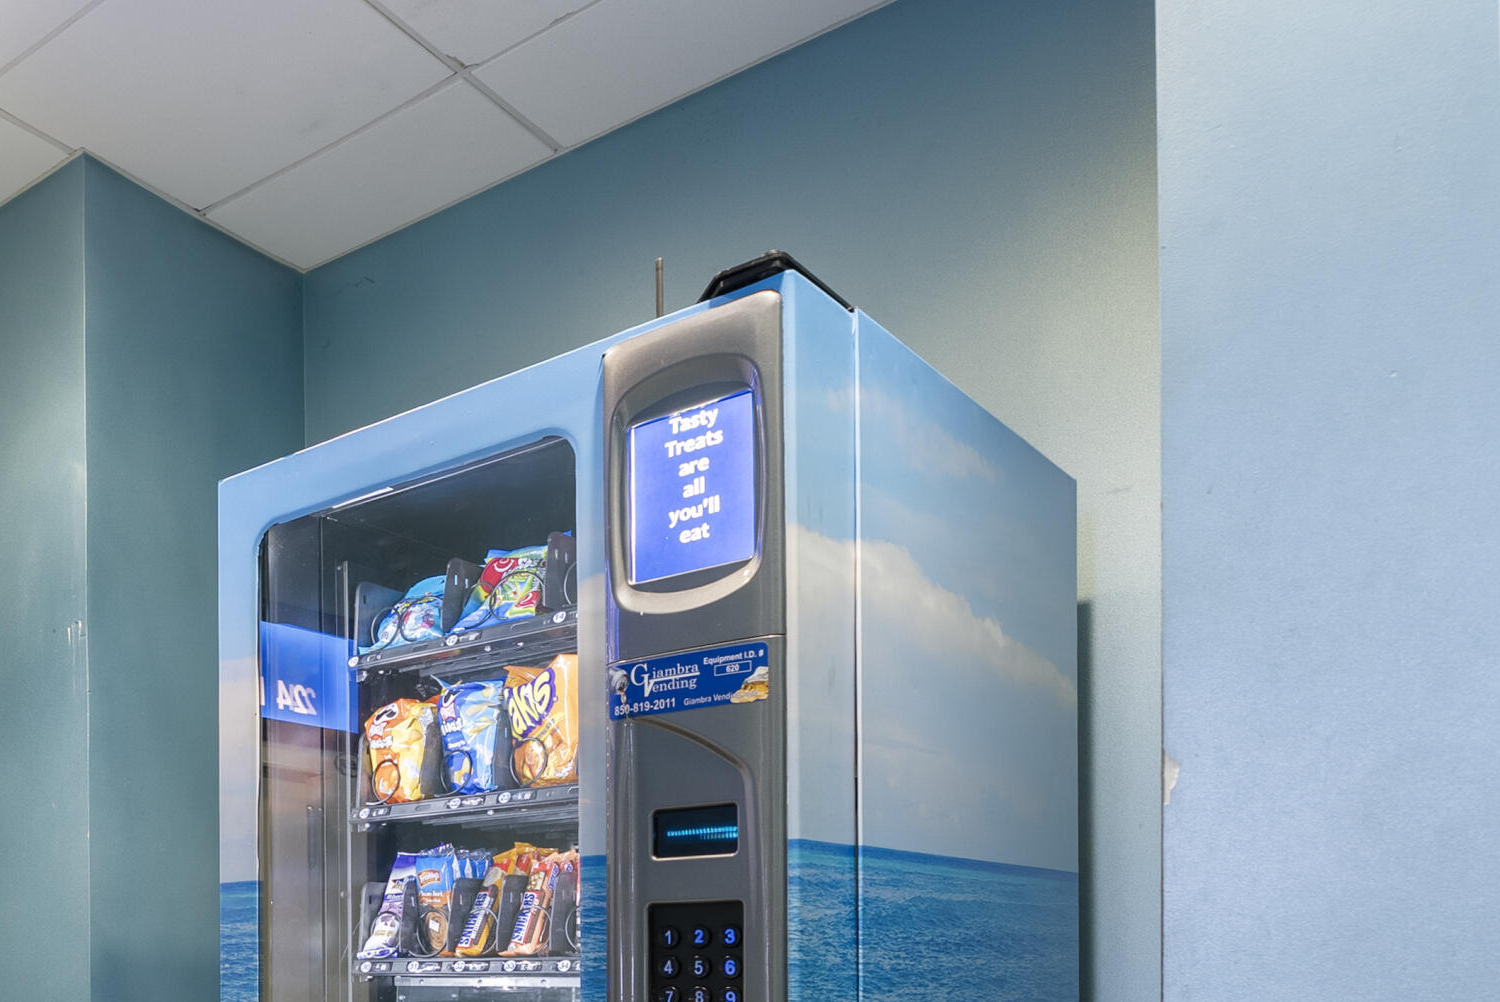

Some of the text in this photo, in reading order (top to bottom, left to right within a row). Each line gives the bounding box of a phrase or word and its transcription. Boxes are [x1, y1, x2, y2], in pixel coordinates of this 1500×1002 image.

[668, 408, 719, 435] Tasty
[664, 428, 724, 458] Treats
[678, 456, 710, 478] are
[682, 476, 705, 499] all
[668, 495, 721, 529] you'll
[679, 522, 711, 544] eat
[703, 652, 743, 666] Equipment
[744, 650, 757, 659] I.D.
[630, 663, 699, 686] Giambra
[644, 677, 698, 698] Vending
[614, 697, 676, 716] 850-819-2011
[683, 695, 712, 706] Giambra
[459, 893, 488, 946] SNICKRS
[664, 928, 735, 945] 1 2 3
[663, 960, 735, 975] 4 5 6
